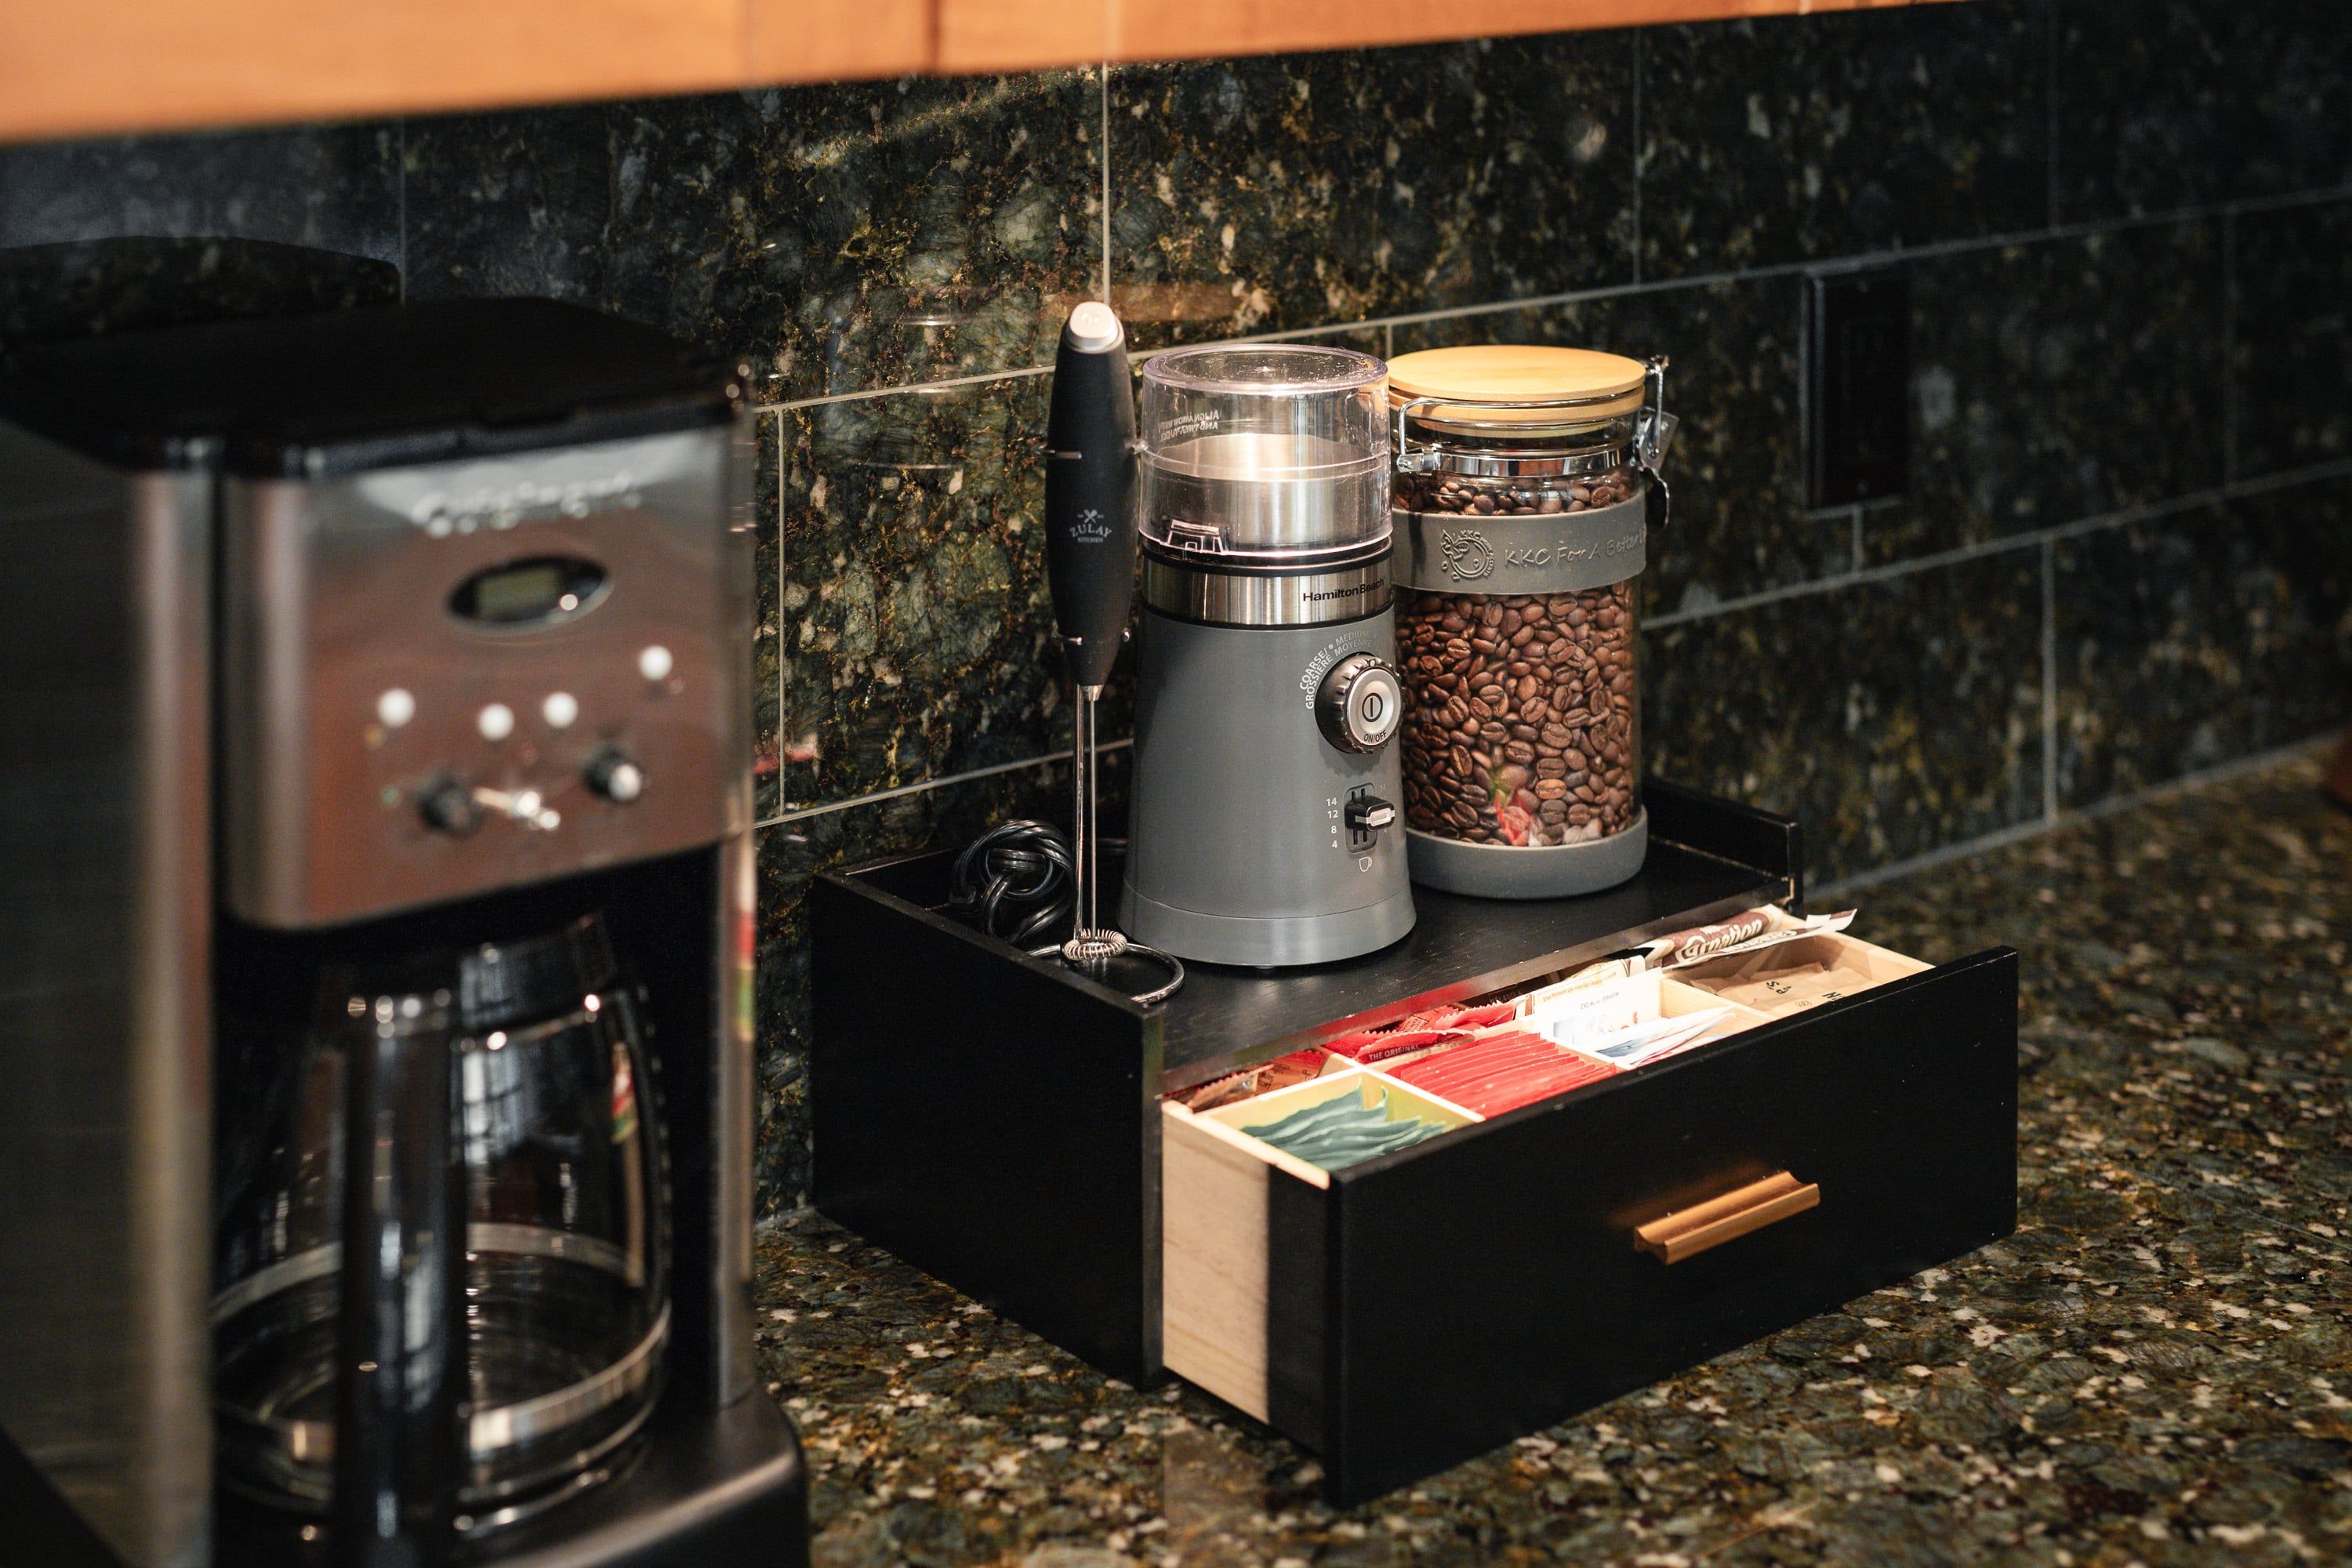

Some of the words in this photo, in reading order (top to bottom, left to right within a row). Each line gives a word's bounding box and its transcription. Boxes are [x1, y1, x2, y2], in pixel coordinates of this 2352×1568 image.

[1069, 524, 1112, 538] ZULAY
[1504, 548, 1551, 567] KKC
[1555, 546, 1587, 564] For
[1588, 543, 1602, 561] A
[1303, 587, 1359, 602] Hamilton
[1359, 579, 1385, 594] Beach
[1363, 730, 1387, 742] ON/OFF
[1326, 797, 1338, 807] 14
[1327, 810, 1339, 819] 12
[1330, 826, 1338, 834] 8
[1675, 919, 1762, 964] Carnation
[1368, 1051, 1384, 1062] THE
